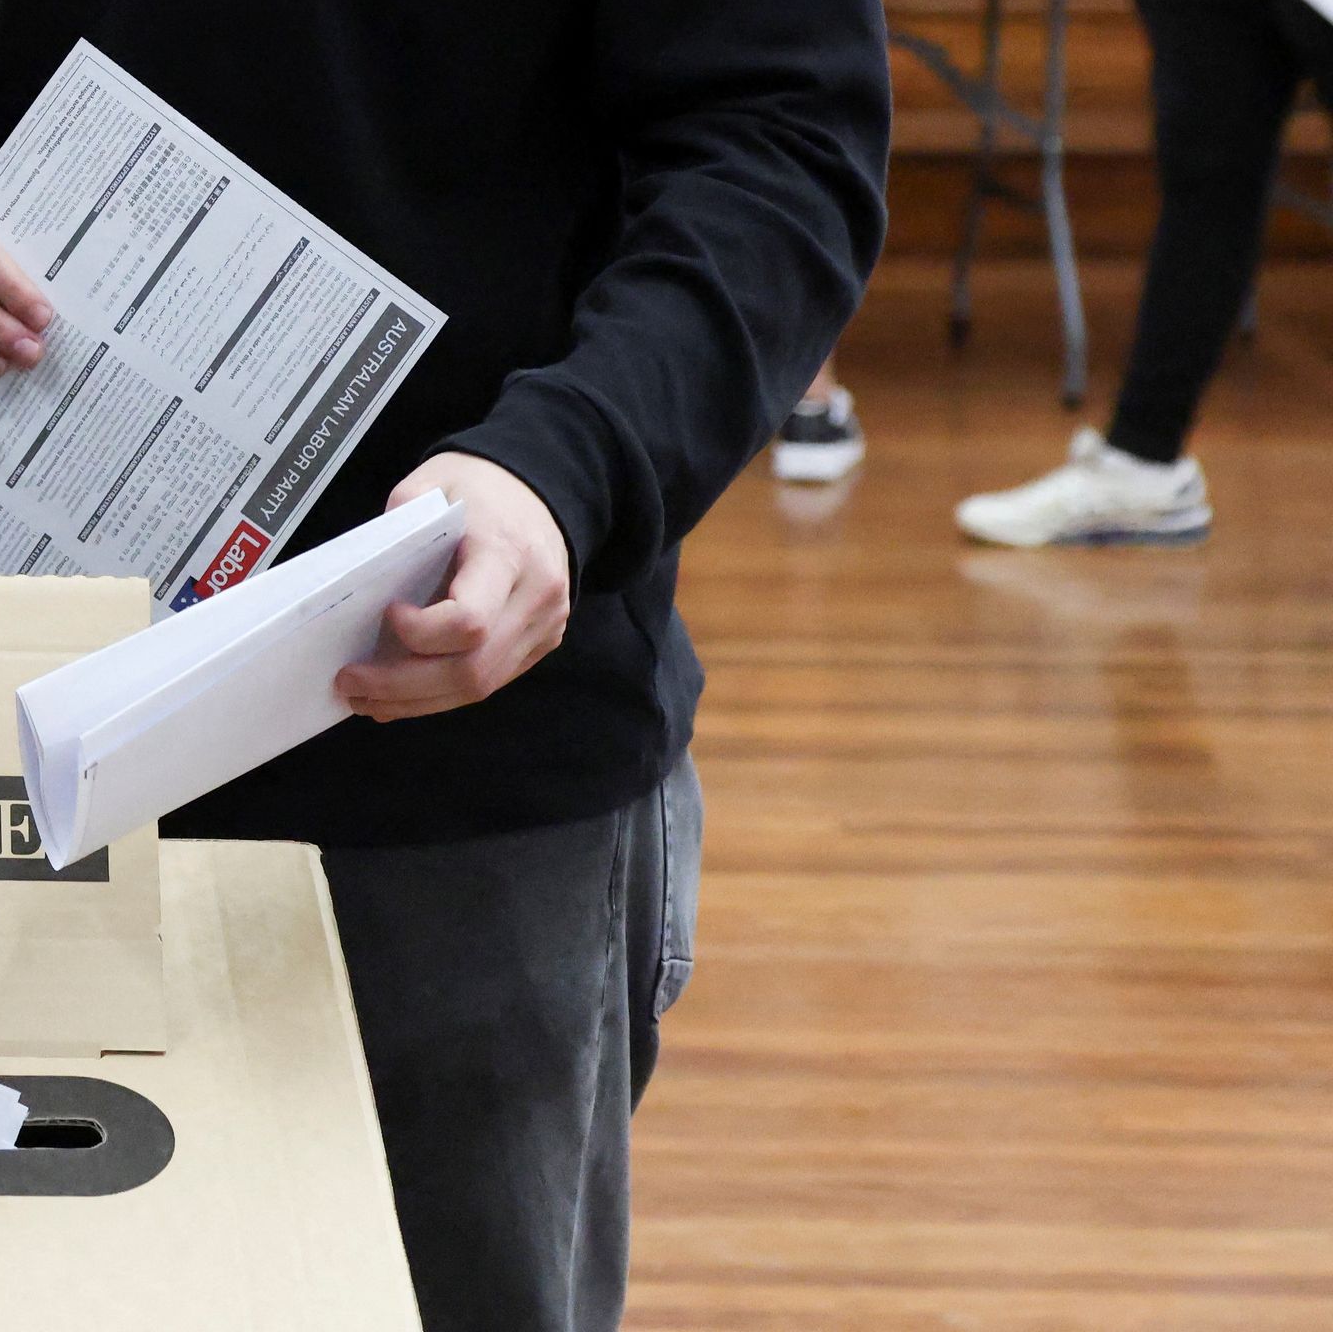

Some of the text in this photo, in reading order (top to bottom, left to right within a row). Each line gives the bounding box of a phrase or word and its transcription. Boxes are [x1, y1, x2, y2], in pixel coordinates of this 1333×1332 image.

[47, 258, 63, 277] GREEK
[116, 306, 136, 331] CHINESE
[196, 367, 214, 390] ARABIC
[257, 316, 409, 521] AUSTRALIAN LABOR PARTY
[265, 417, 284, 442] ENGLISH
[205, 530, 260, 595] Labor
